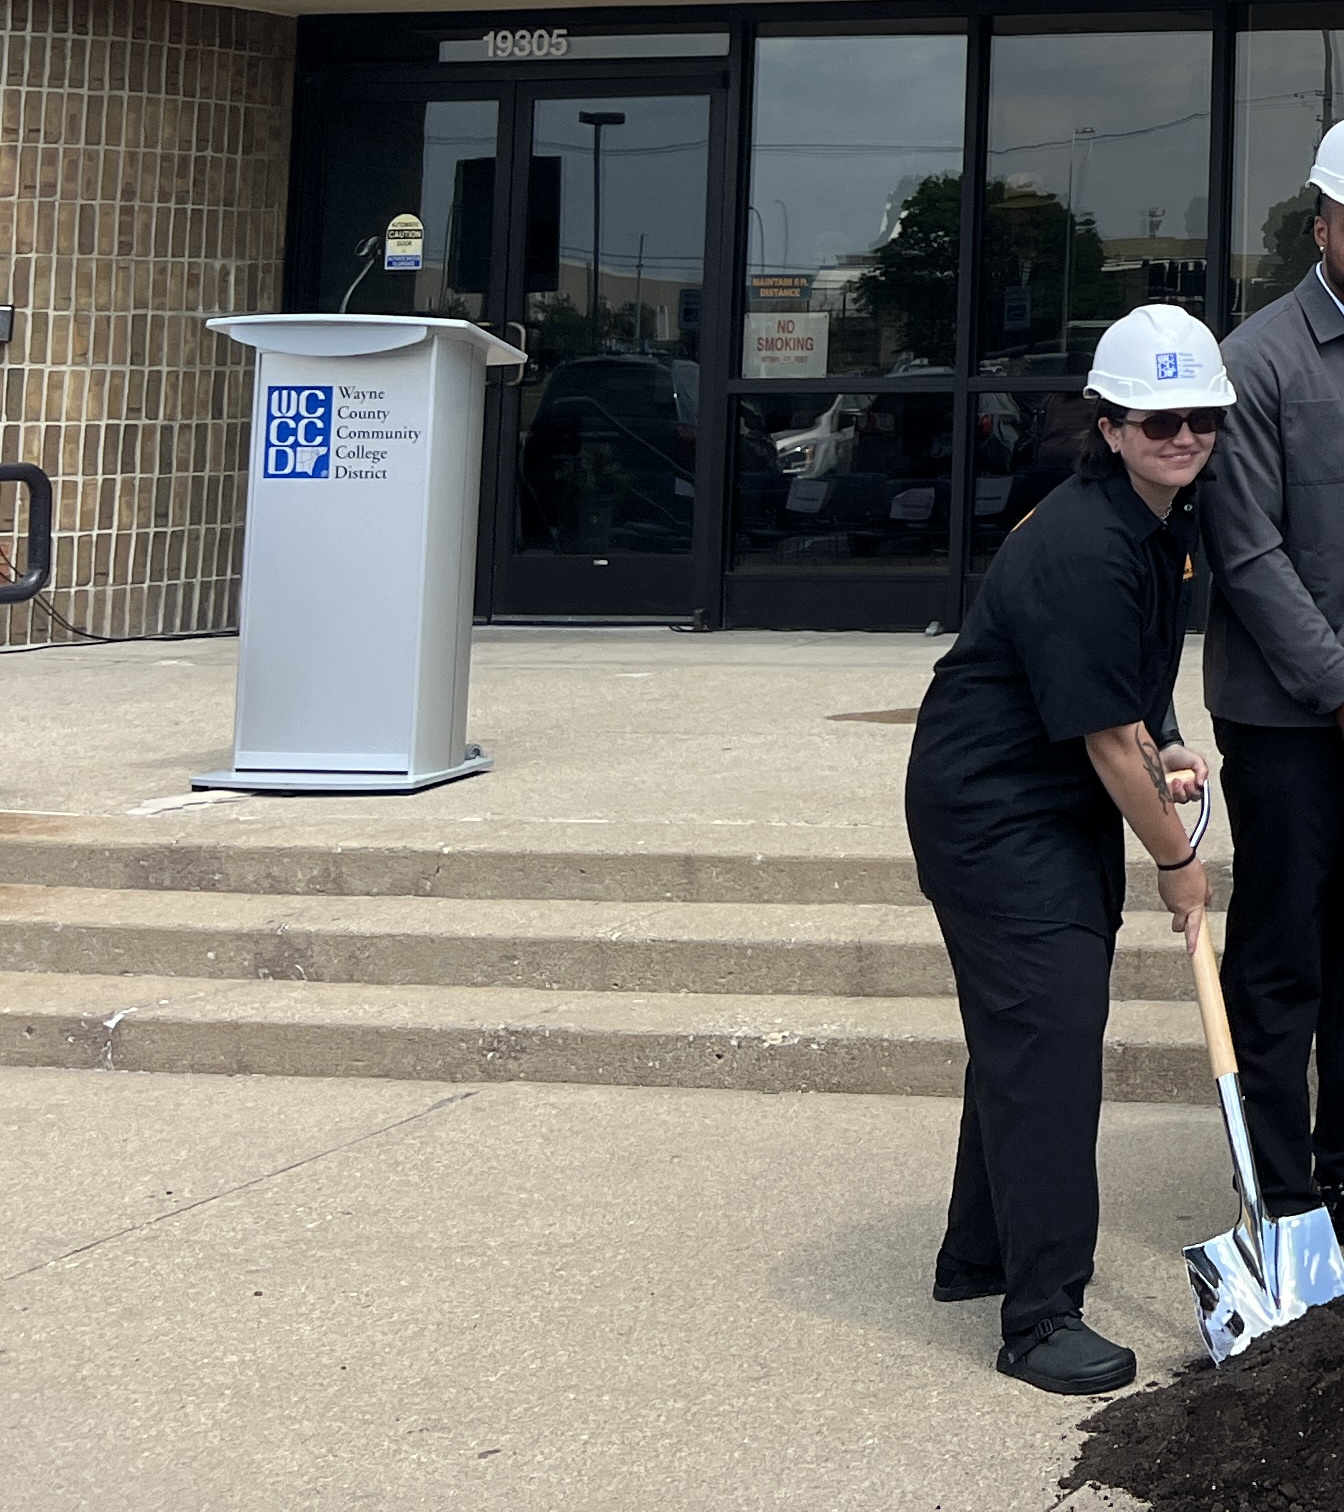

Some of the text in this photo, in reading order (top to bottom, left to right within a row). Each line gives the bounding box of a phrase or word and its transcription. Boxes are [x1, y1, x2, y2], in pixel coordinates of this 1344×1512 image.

[483, 28, 568, 58] 19305
[389, 230, 421, 239] CAUTION
[760, 288, 801, 298] DISTANCE
[777, 319, 796, 335] NO
[757, 336, 815, 352] SMOKING
[338, 386, 386, 404] Wayne
[337, 406, 390, 424] County
[269, 418, 325, 446] CC
[336, 426, 422, 444] Community
[335, 445, 388, 464] College
[335, 465, 388, 480] District
